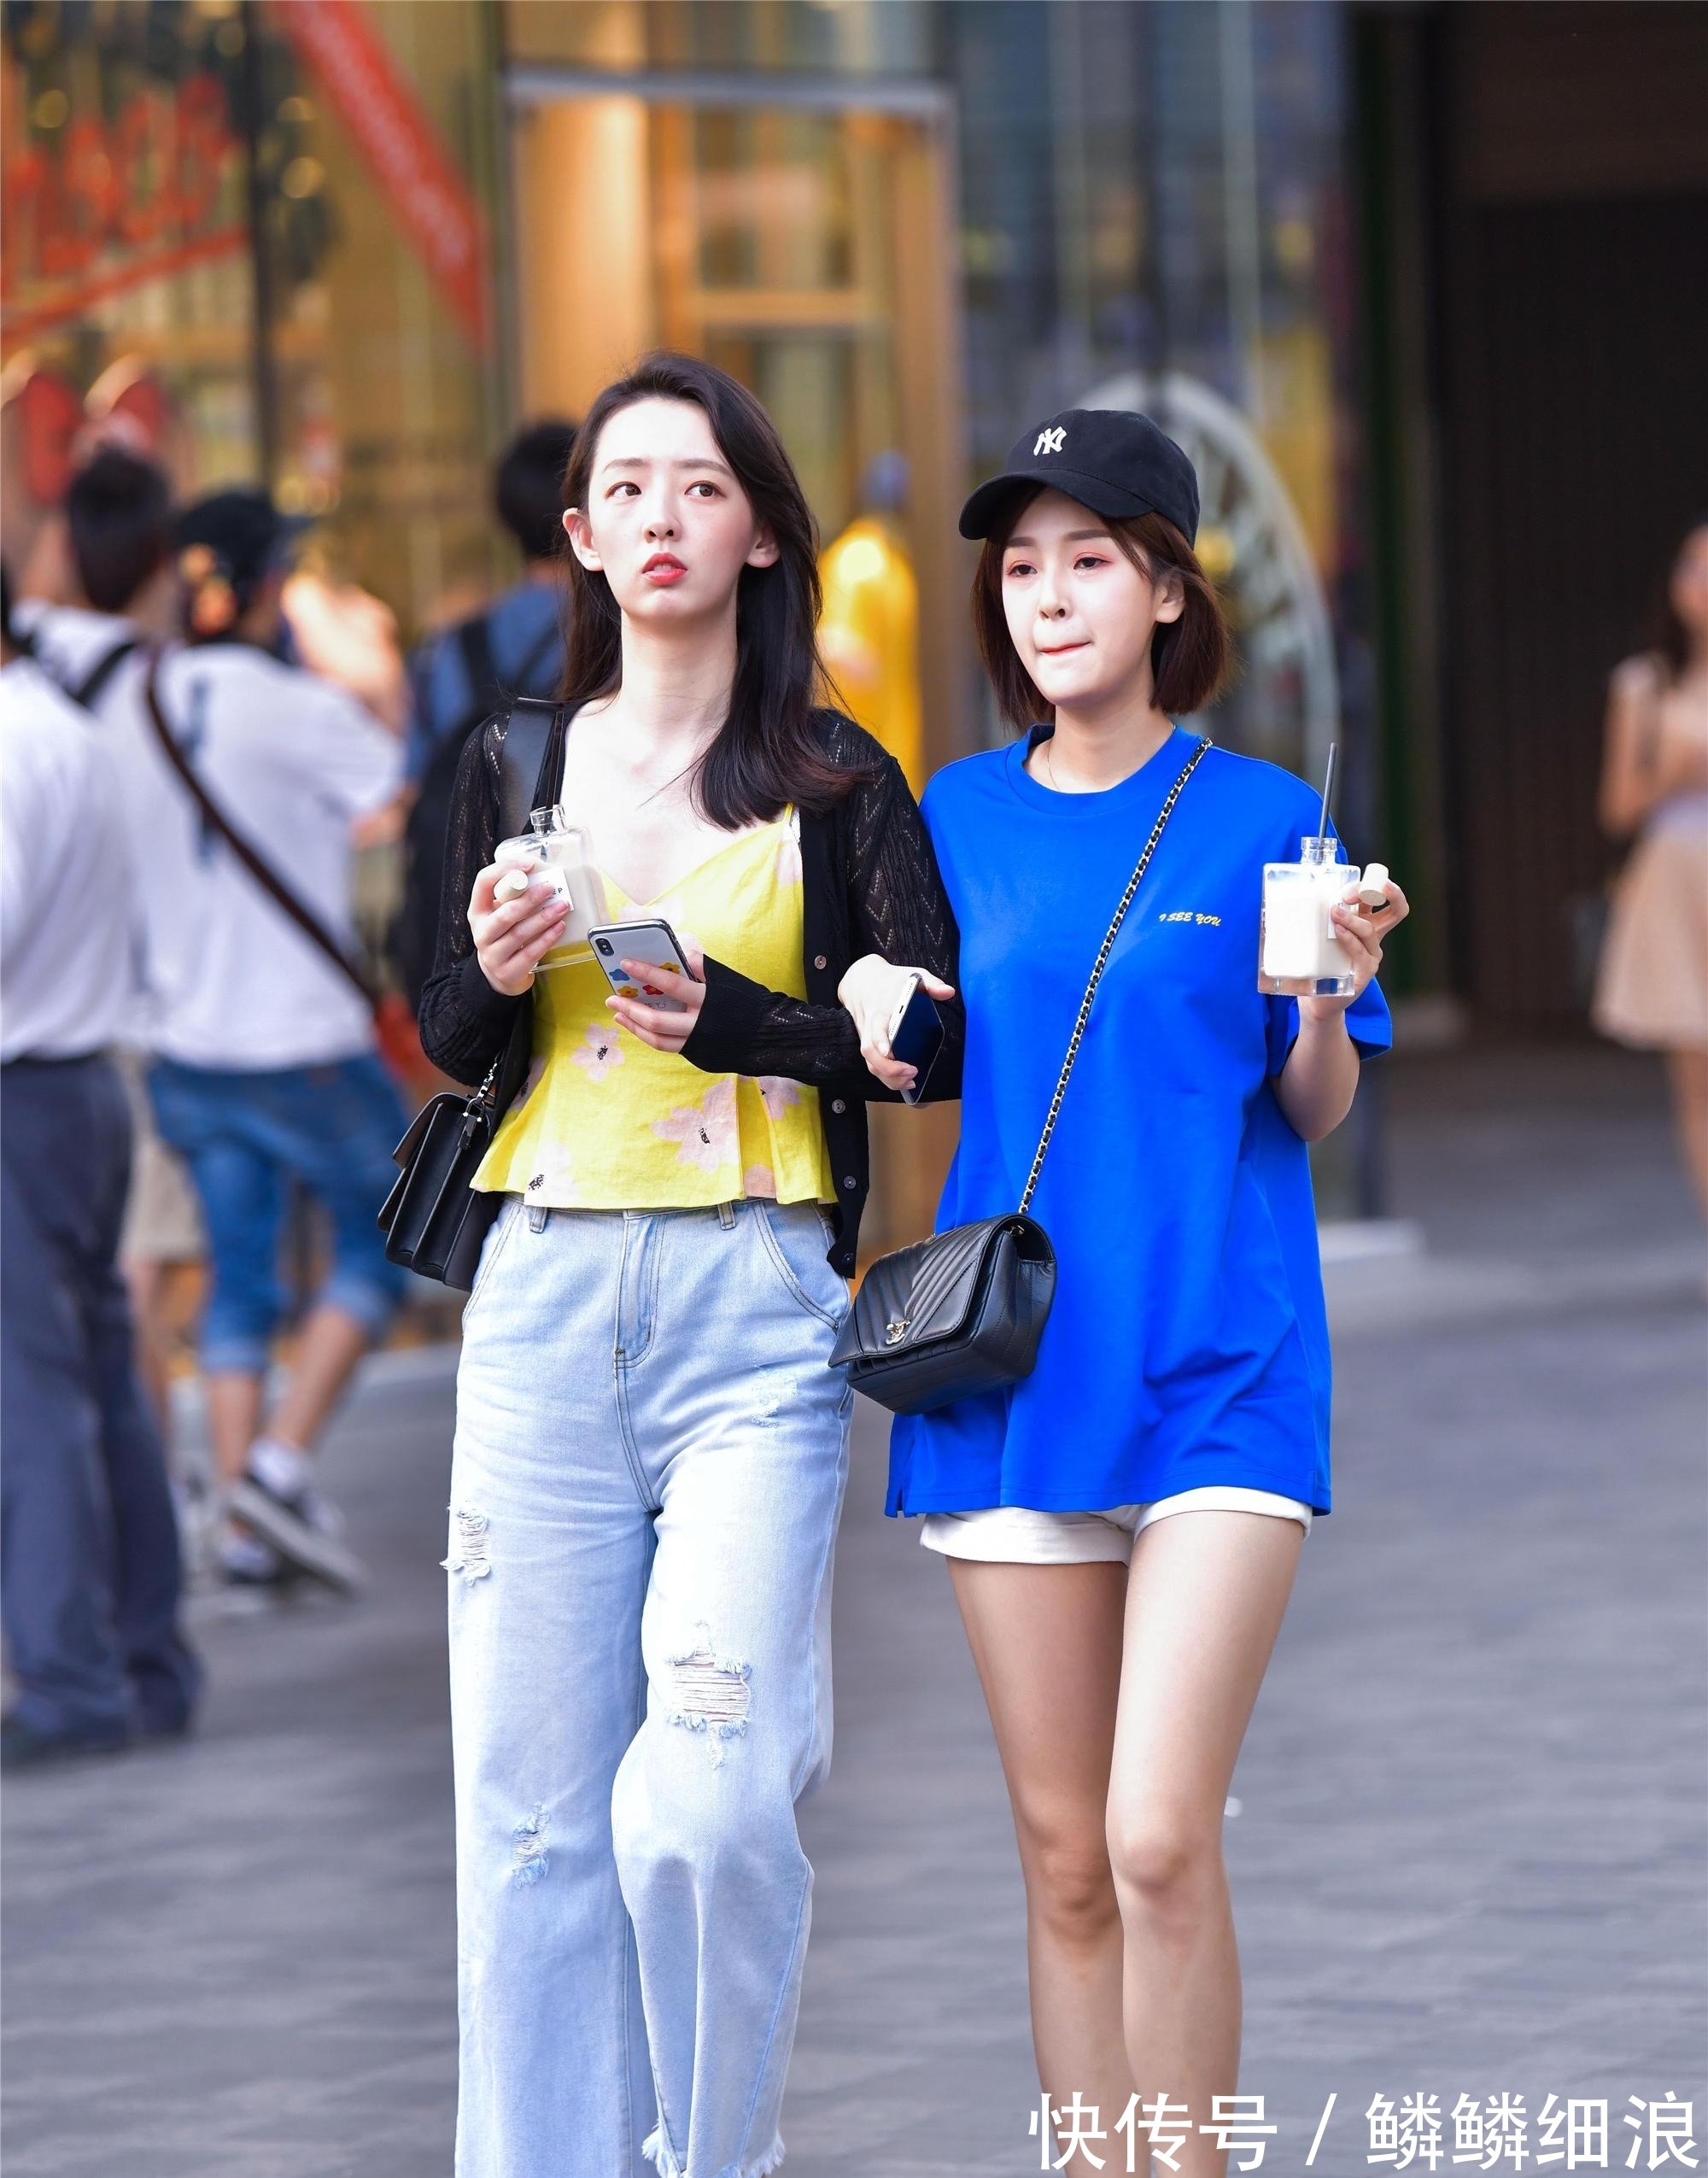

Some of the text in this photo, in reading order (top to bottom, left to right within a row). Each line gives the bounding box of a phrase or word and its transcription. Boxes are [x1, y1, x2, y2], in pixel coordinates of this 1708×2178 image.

[1032, 425, 1068, 456] NY
[1167, 911, 1194, 922] SEE
[1196, 913, 1222, 927] YOU
